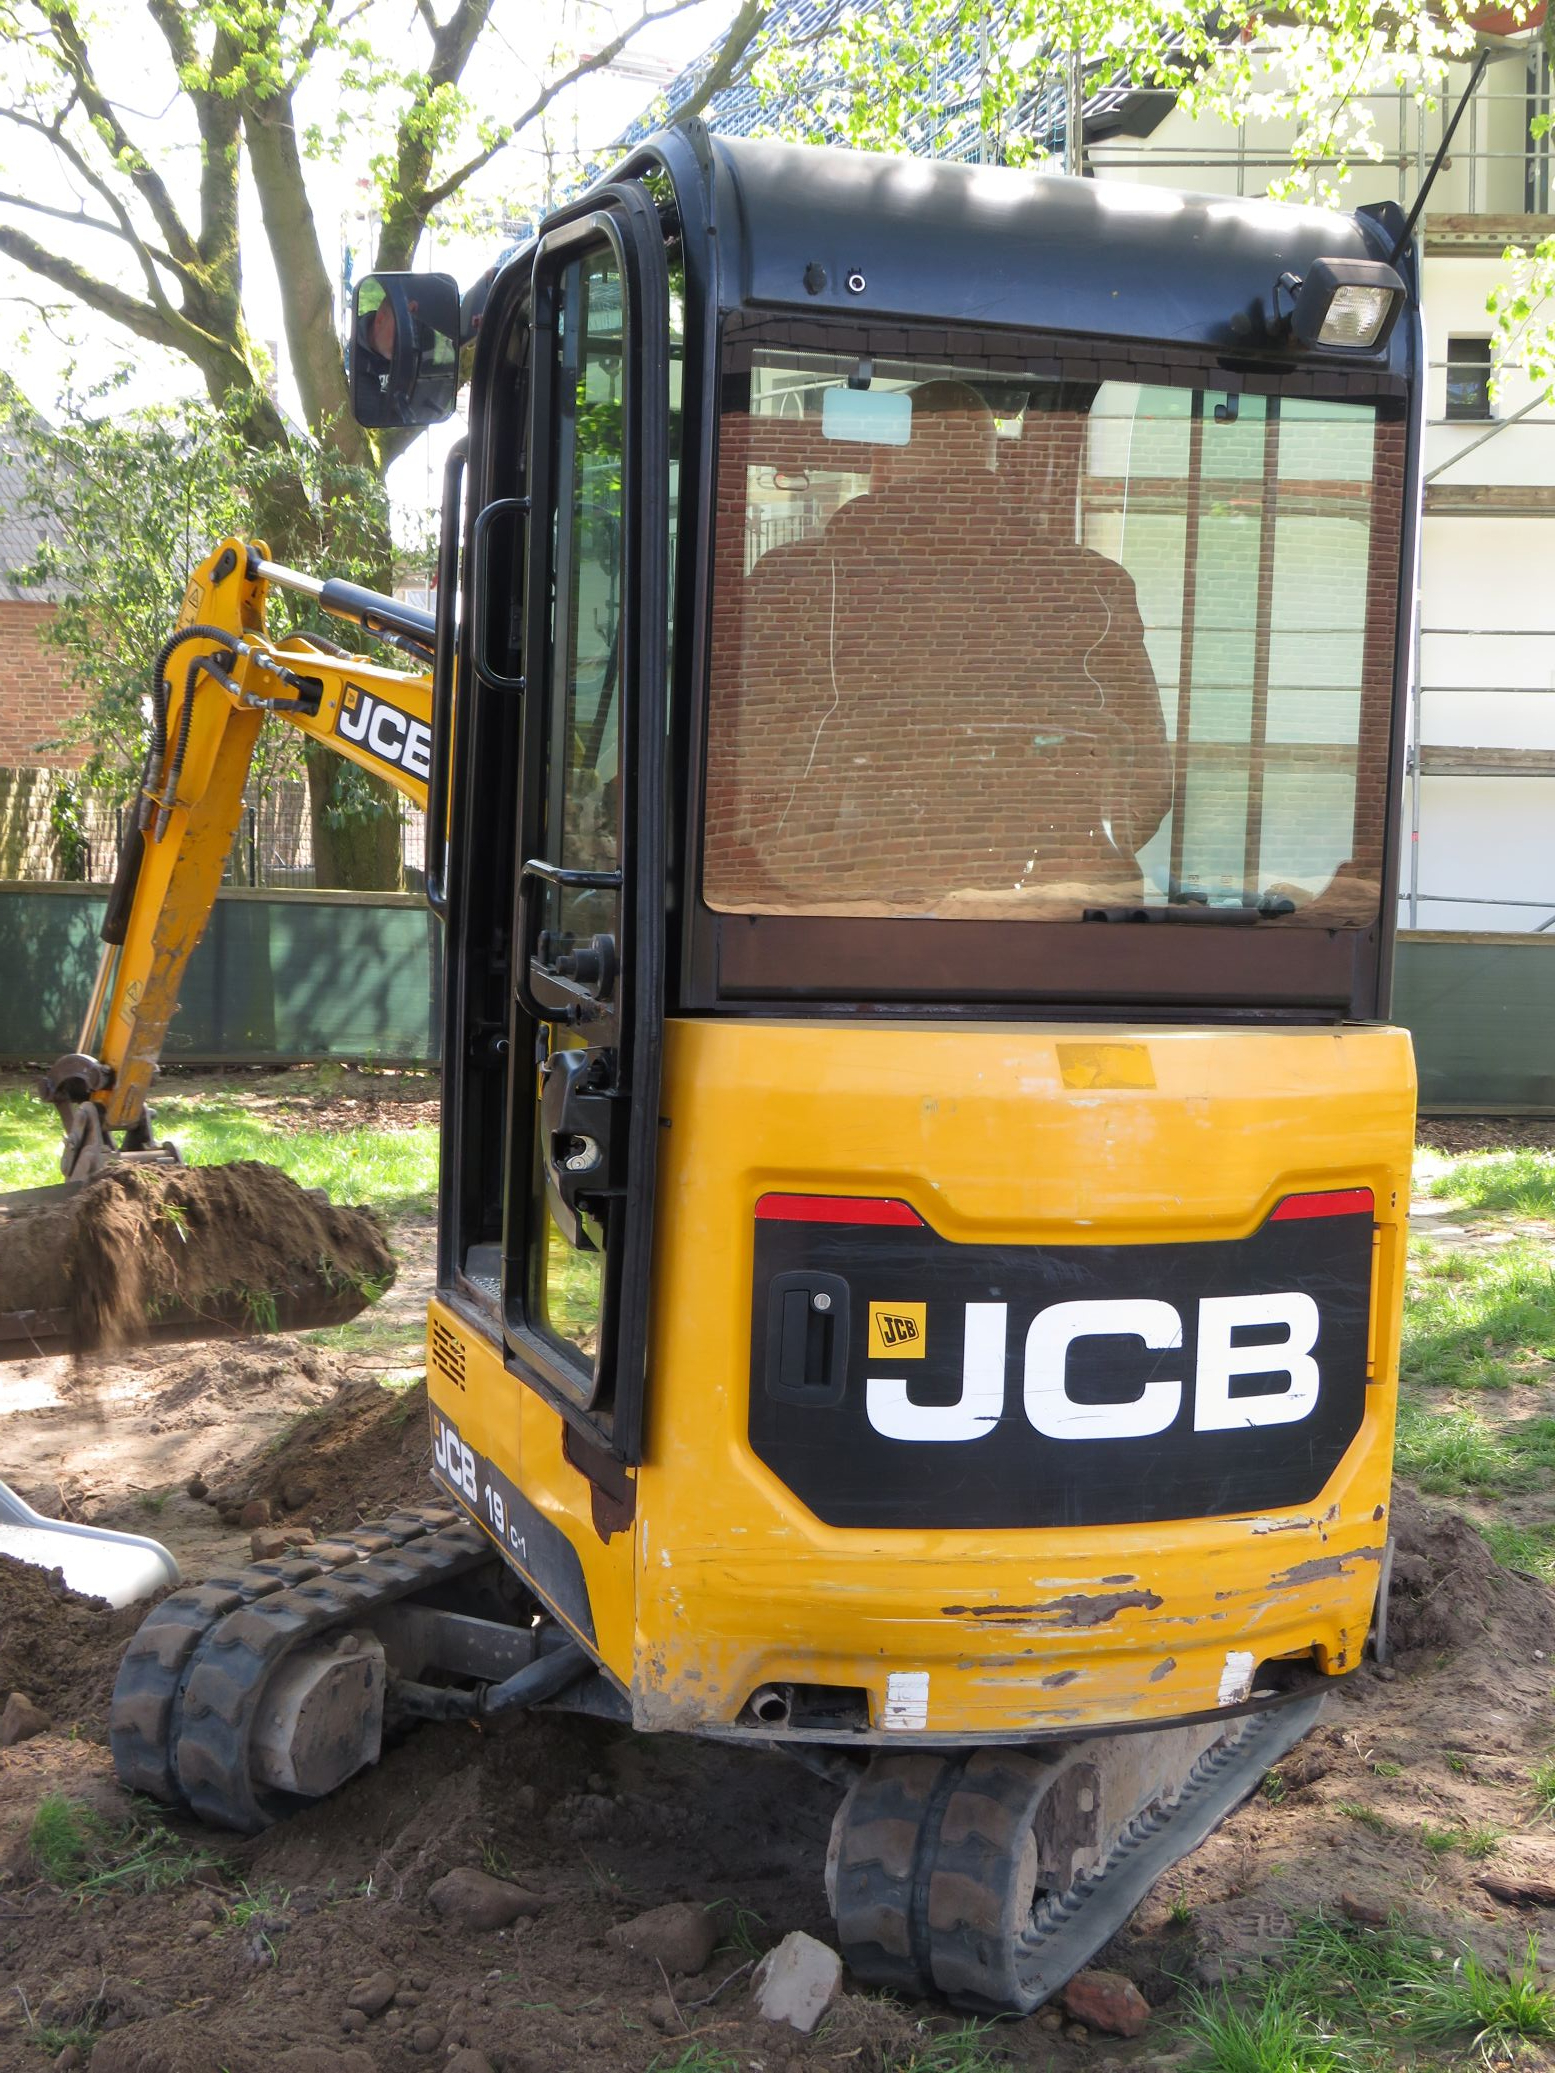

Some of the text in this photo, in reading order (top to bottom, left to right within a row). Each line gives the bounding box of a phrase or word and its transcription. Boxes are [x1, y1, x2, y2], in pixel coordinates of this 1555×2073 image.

[866, 1292, 1320, 1441] JCB
[883, 1316, 917, 1344] JCB
[435, 1421, 477, 1503] JCB
[484, 1483, 505, 1534] 19
